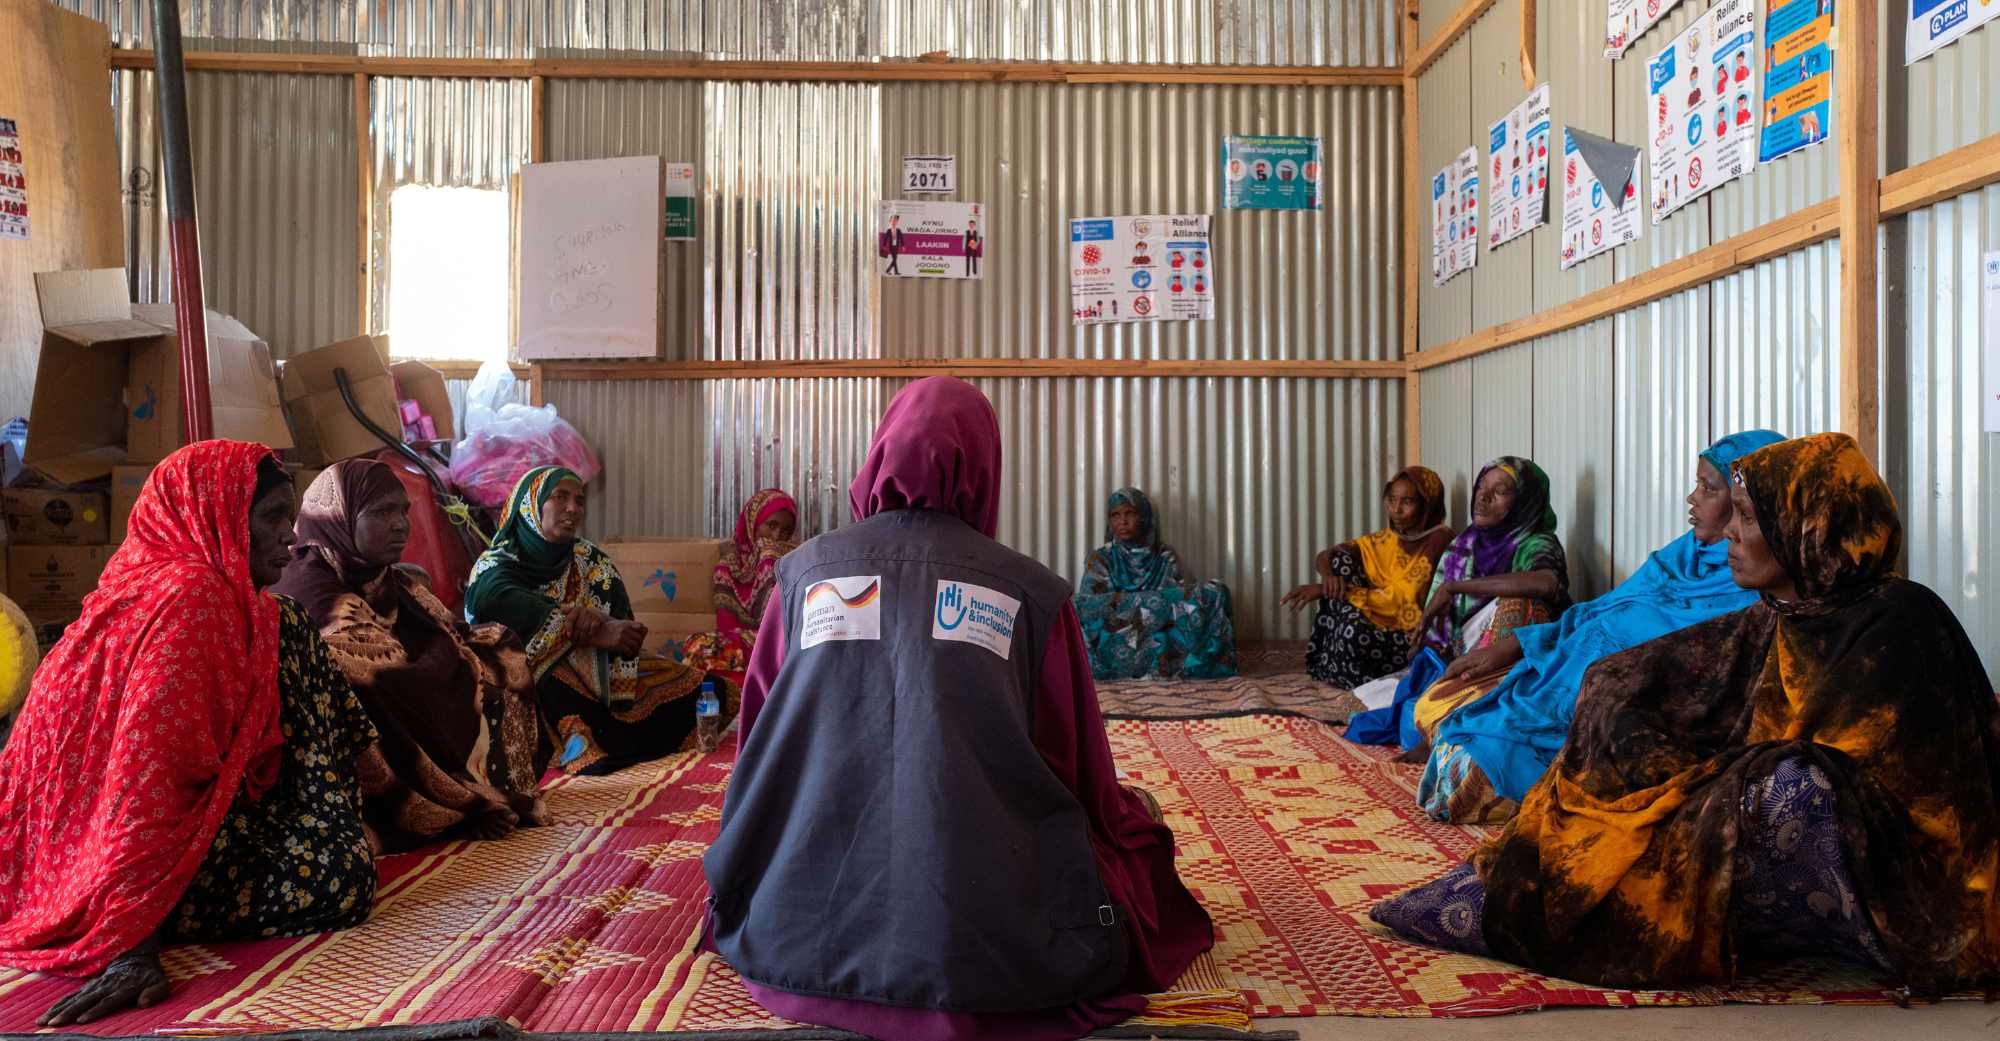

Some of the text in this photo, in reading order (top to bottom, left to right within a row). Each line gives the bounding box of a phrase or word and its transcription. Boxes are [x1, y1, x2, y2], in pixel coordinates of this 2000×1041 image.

[1945, 1, 1966, 23] PLAN
[910, 172, 947, 188] 2071
[1172, 218, 1199, 227] Relief
[1172, 229, 1208, 239] Alliance
[945, 584, 962, 611] Hi
[970, 597, 1014, 627] humanity
